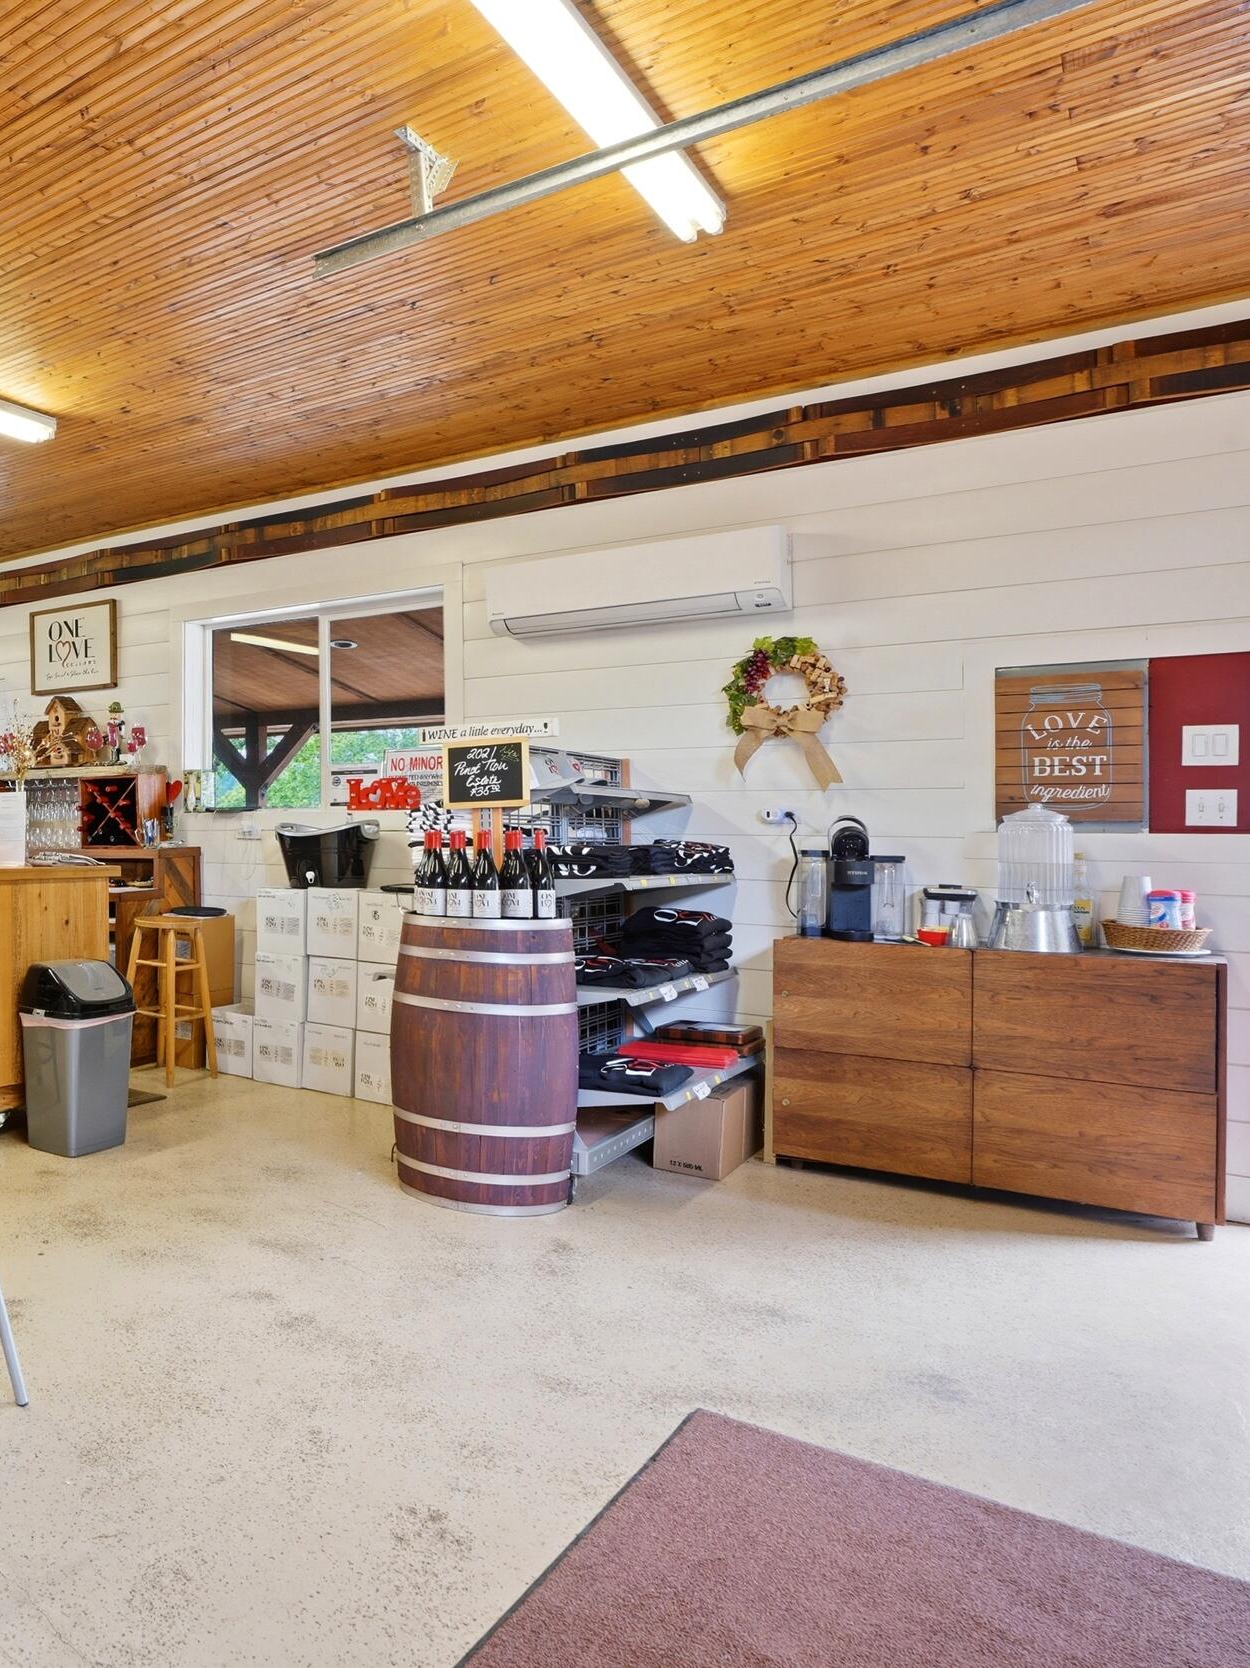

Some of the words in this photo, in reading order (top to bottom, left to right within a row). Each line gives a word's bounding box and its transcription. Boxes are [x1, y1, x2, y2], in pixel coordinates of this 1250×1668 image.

[49, 617, 86, 641] ONE
[427, 729, 458, 741] WINE
[468, 725, 489, 737] little
[1026, 712, 1108, 741] LOVE
[1046, 737, 1064, 751] is
[1064, 735, 1093, 751] the
[466, 746, 497, 759] 2021
[390, 757, 406, 772] NO
[453, 761, 482, 776] Pinot
[1032, 755, 1107, 777] BEST
[1030, 783, 1110, 804] ingredient
